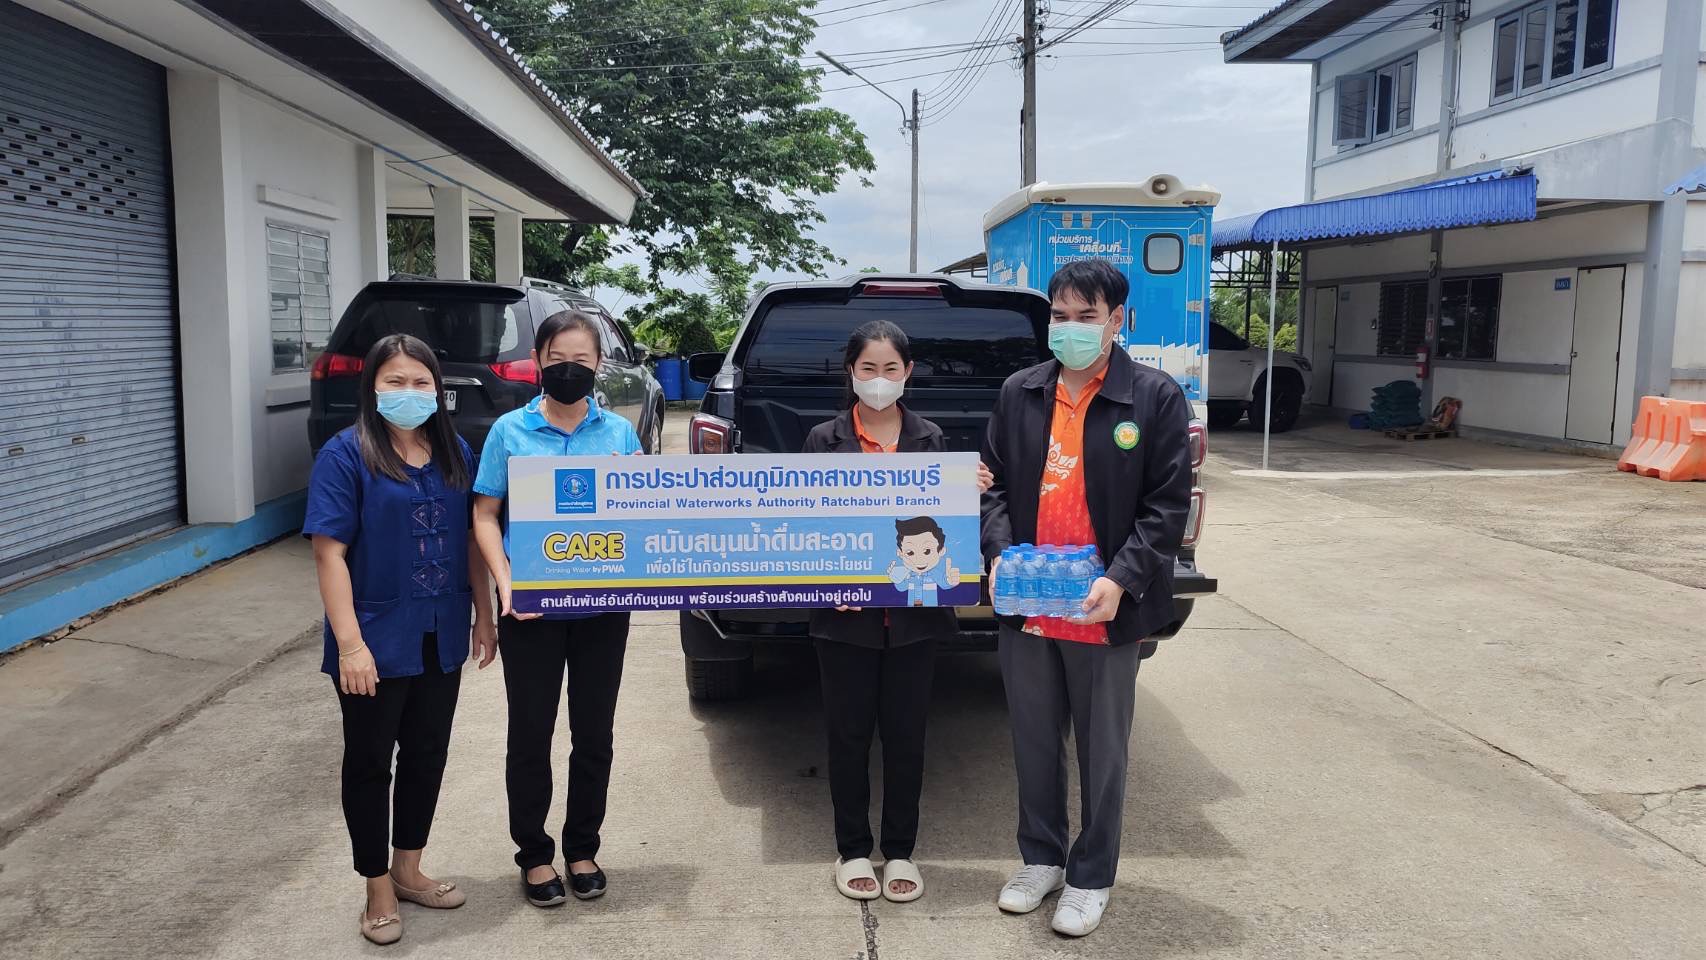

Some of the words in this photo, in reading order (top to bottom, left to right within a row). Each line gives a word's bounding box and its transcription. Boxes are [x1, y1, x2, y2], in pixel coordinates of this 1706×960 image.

[606, 464, 941, 493] การประปาส่วนภูมิภาคสาขาราชบุรี
[606, 498, 670, 509] Provincial
[676, 497, 752, 508] Waterworks
[757, 497, 816, 509] Authority
[821, 496, 890, 507] Ratchaburi
[896, 496, 941, 506] Branch
[544, 532, 625, 561] CARE
[644, 522, 874, 558] สนับสนุนน้ำดื่มสะอาด
[646, 557, 872, 574] เพื่อใช้ในกิจกรรมสาธารณประโยชน์
[540, 593, 684, 608] สานสัมพันธ์อันดีกับชุมชน
[689, 588, 872, 605] พร้อมร่วมสร้างสังคมน่าอยู่ต่อไป
